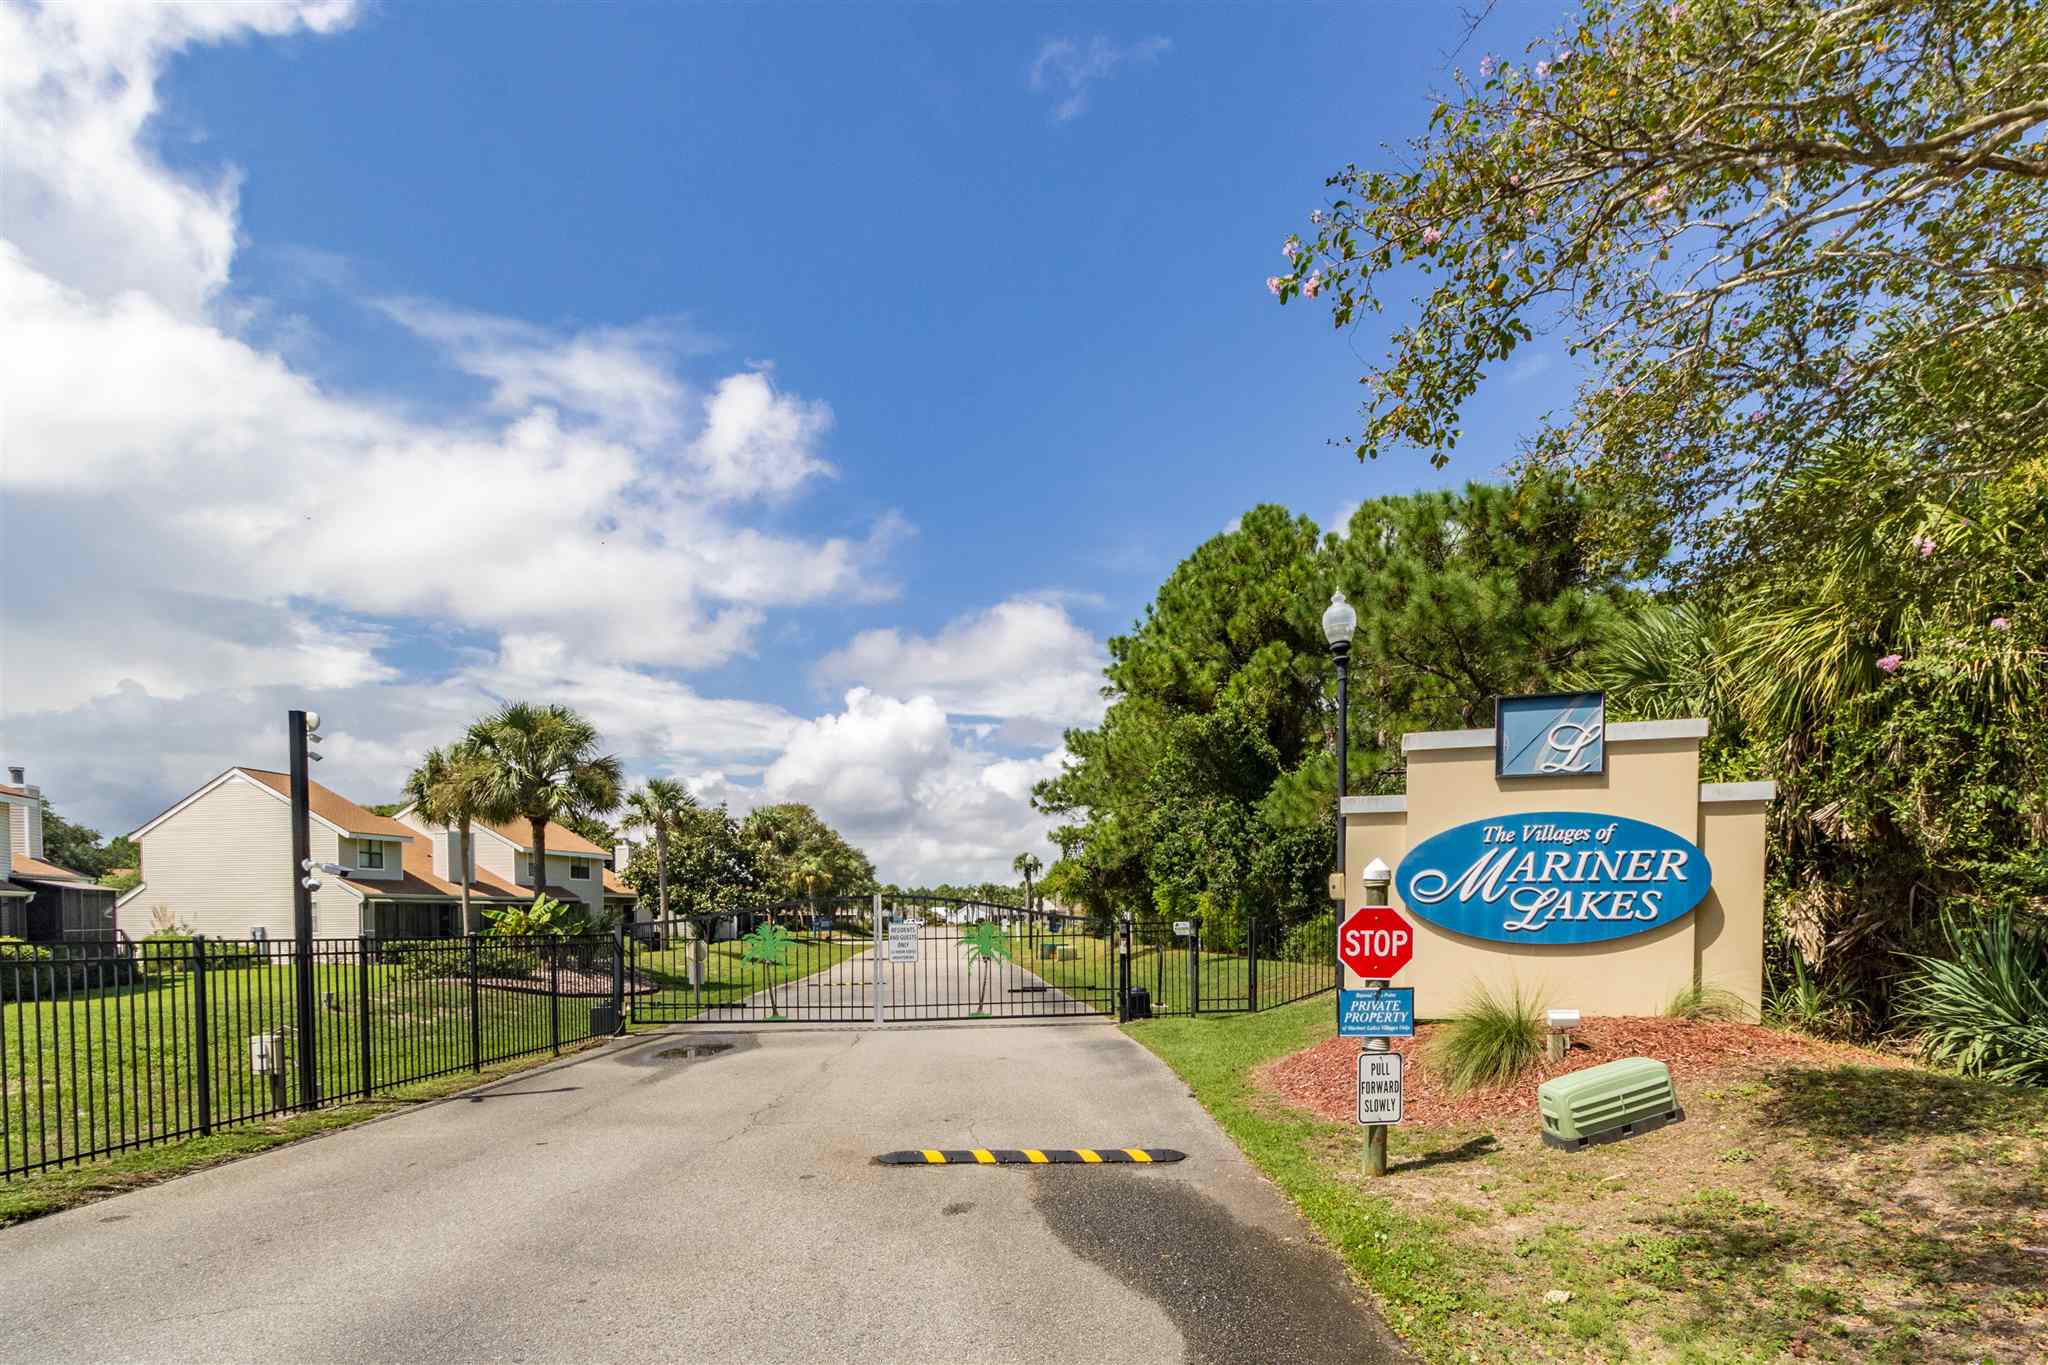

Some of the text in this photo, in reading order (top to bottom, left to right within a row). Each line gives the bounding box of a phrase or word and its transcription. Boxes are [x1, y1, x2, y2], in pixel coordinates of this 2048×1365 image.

[1483, 823, 1618, 845] The Villages of
[1410, 847, 1689, 903] MARINER
[1503, 887, 1662, 931] LAKES
[1345, 930, 1408, 957] STOP
[1350, 1000, 1402, 1012] PRIVATE
[1344, 1011, 1409, 1023] PROPERTY
[1371, 1062, 1390, 1076] PULL
[1361, 1080, 1399, 1095] FORWARD
[1364, 1098, 1395, 1112] SLOWLY
